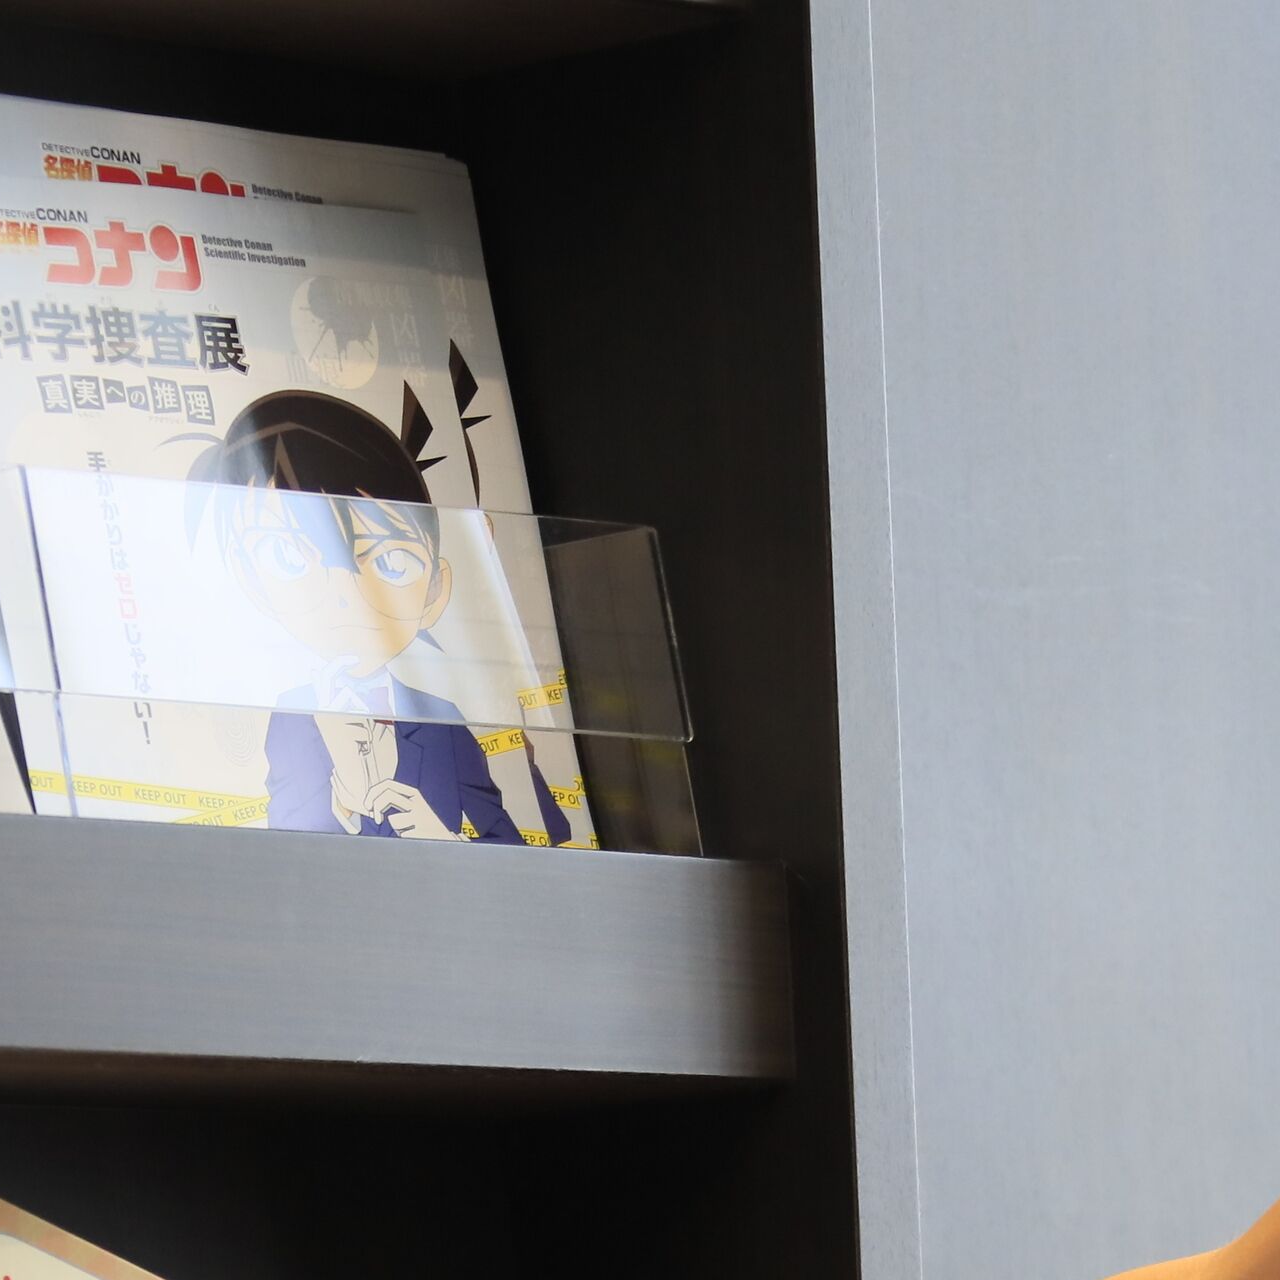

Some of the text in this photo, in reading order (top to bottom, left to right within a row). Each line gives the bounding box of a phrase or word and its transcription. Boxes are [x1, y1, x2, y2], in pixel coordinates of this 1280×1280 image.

[42, 143, 141, 165] DETECTIVE CONAN
[35, 208, 88, 223] CONAN
[201, 235, 273, 251] Detective Conan
[42, 218, 203, 292] コナン
[204, 247, 306, 268] Scientific Investigation
[41, 378, 212, 420] 真実への推理
[480, 738, 500, 754] OUT
[71, 779, 97, 793] KEEP
[100, 783, 122, 797] OUT
[134, 788, 160, 802] KEEP
[163, 791, 186, 805] OUT
[198, 795, 225, 809] KEEP
[232, 805, 257, 821] KEEP
